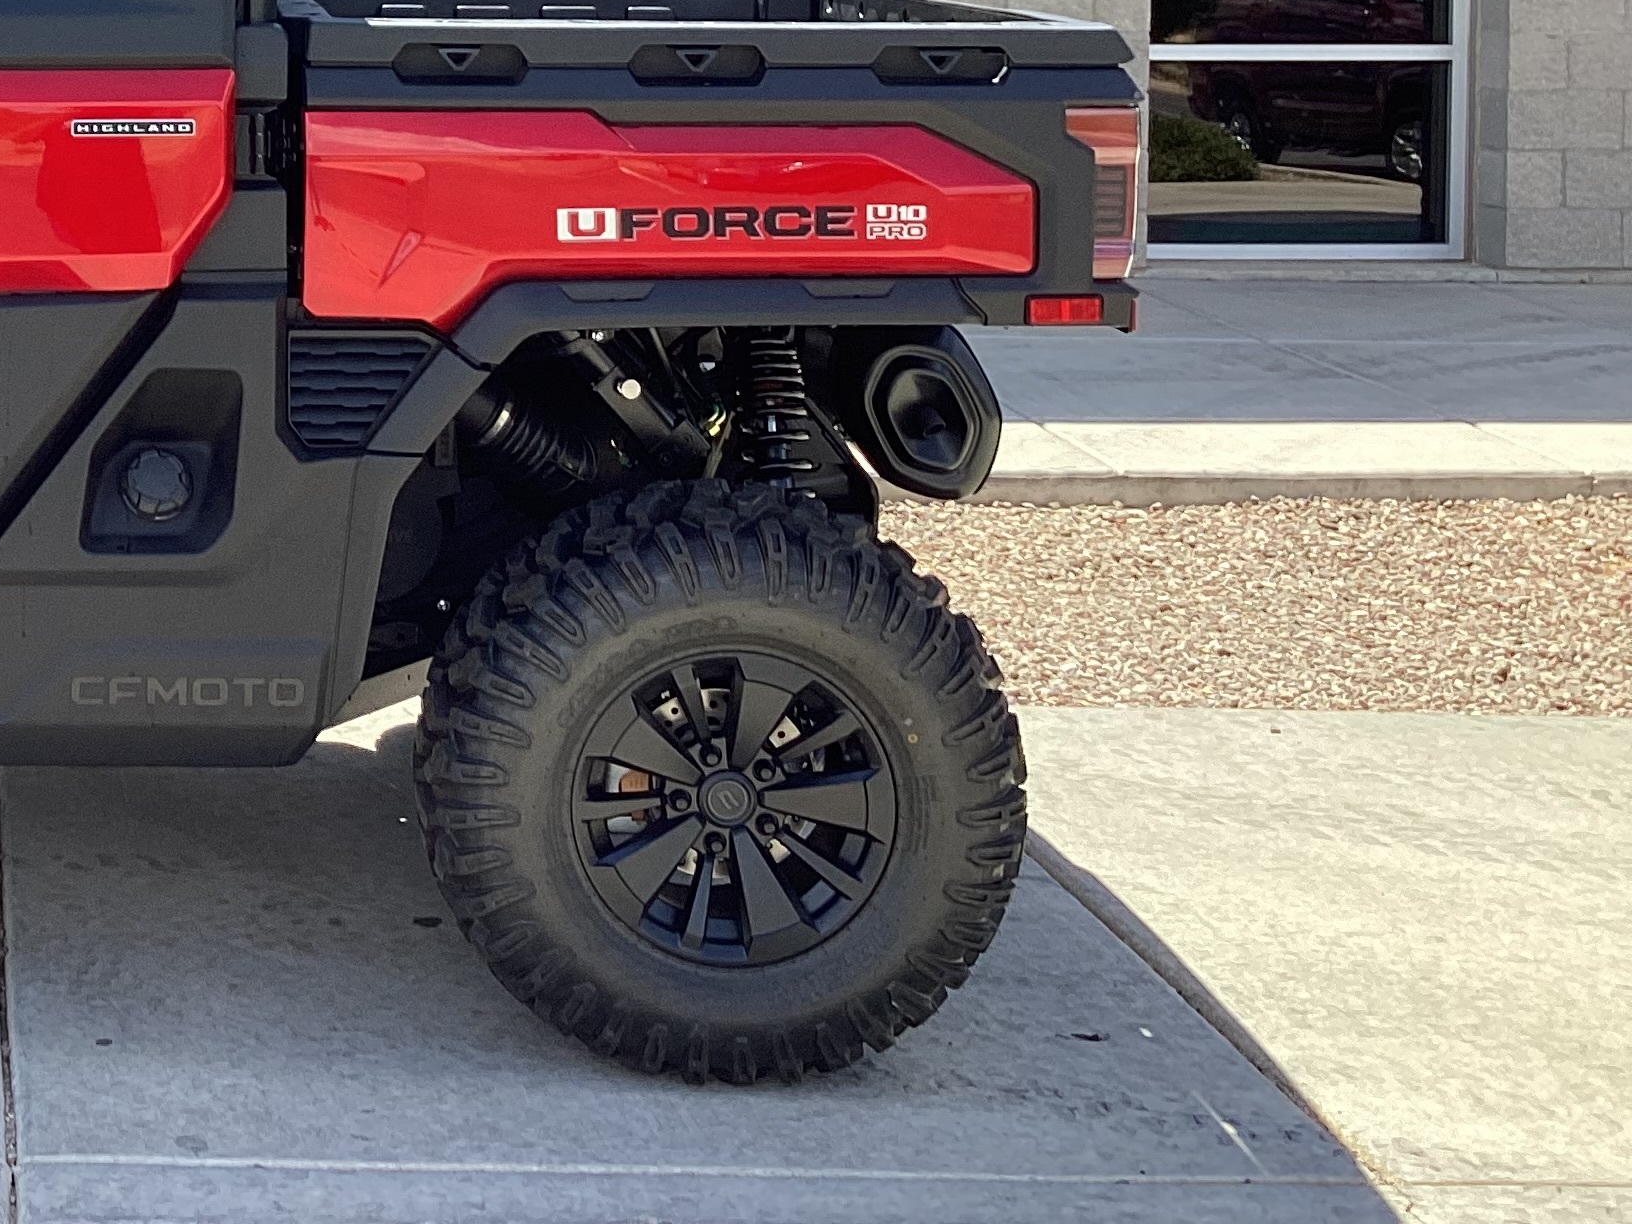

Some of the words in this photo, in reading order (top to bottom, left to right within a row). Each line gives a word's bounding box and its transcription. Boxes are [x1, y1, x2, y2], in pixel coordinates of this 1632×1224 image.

[75, 123, 192, 134] HIGHLAND
[866, 223, 927, 240] PRO
[70, 676, 306, 708] CFMOTO
